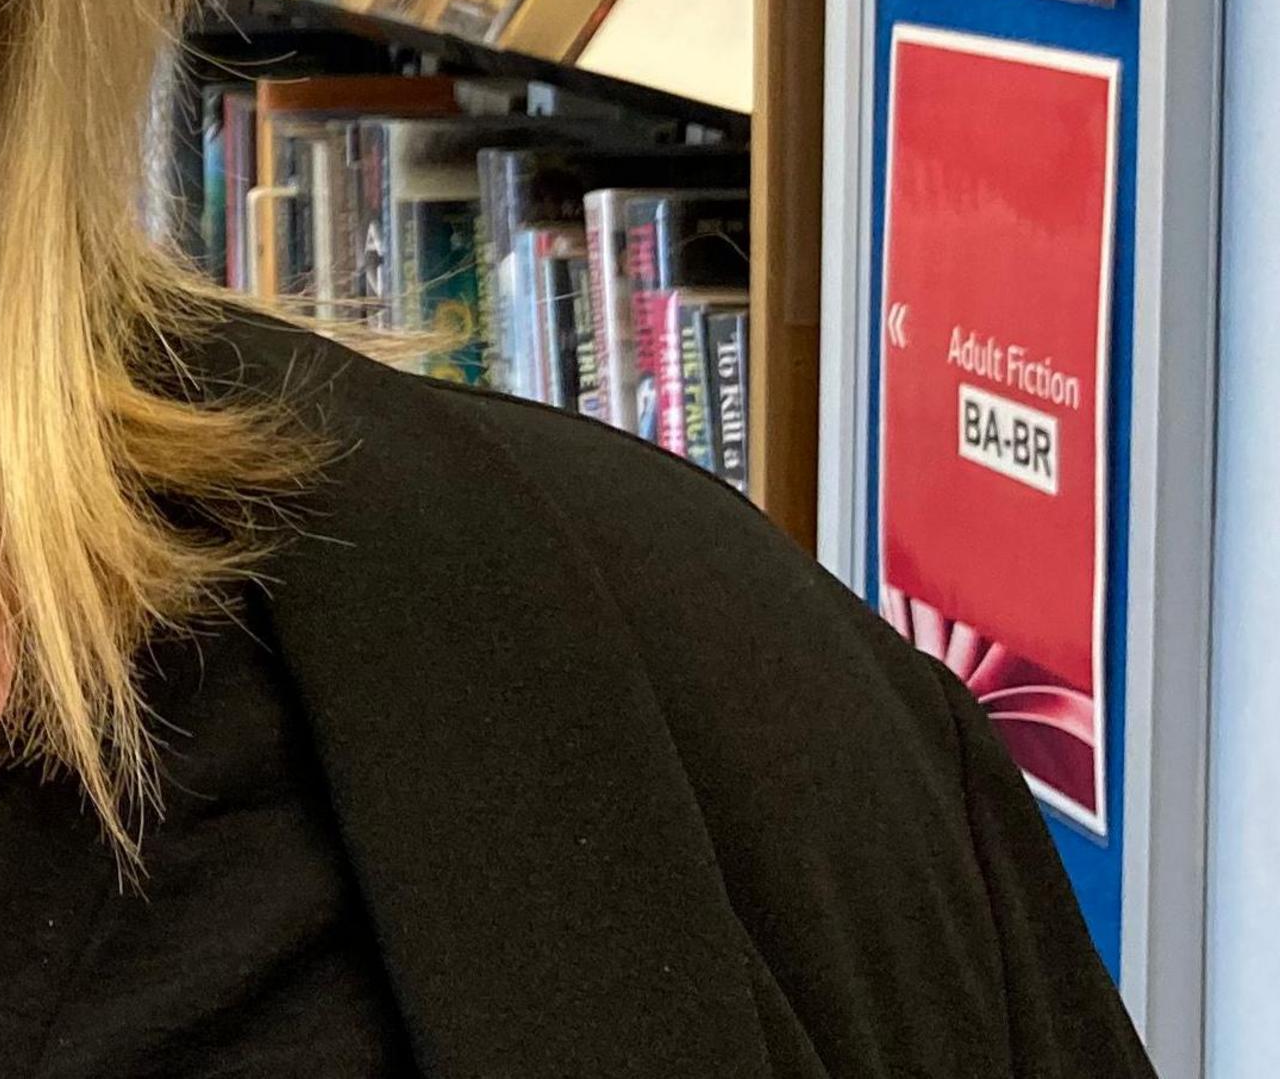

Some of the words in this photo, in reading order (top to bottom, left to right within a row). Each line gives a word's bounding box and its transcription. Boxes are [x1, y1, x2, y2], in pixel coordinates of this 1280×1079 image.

[716, 333, 740, 377] To
[947, 325, 1003, 383] Adult
[1007, 344, 1080, 411] Fiction
[719, 383, 745, 443] Kill
[964, 399, 1051, 477] BA-BR
[724, 447, 741, 469] a
